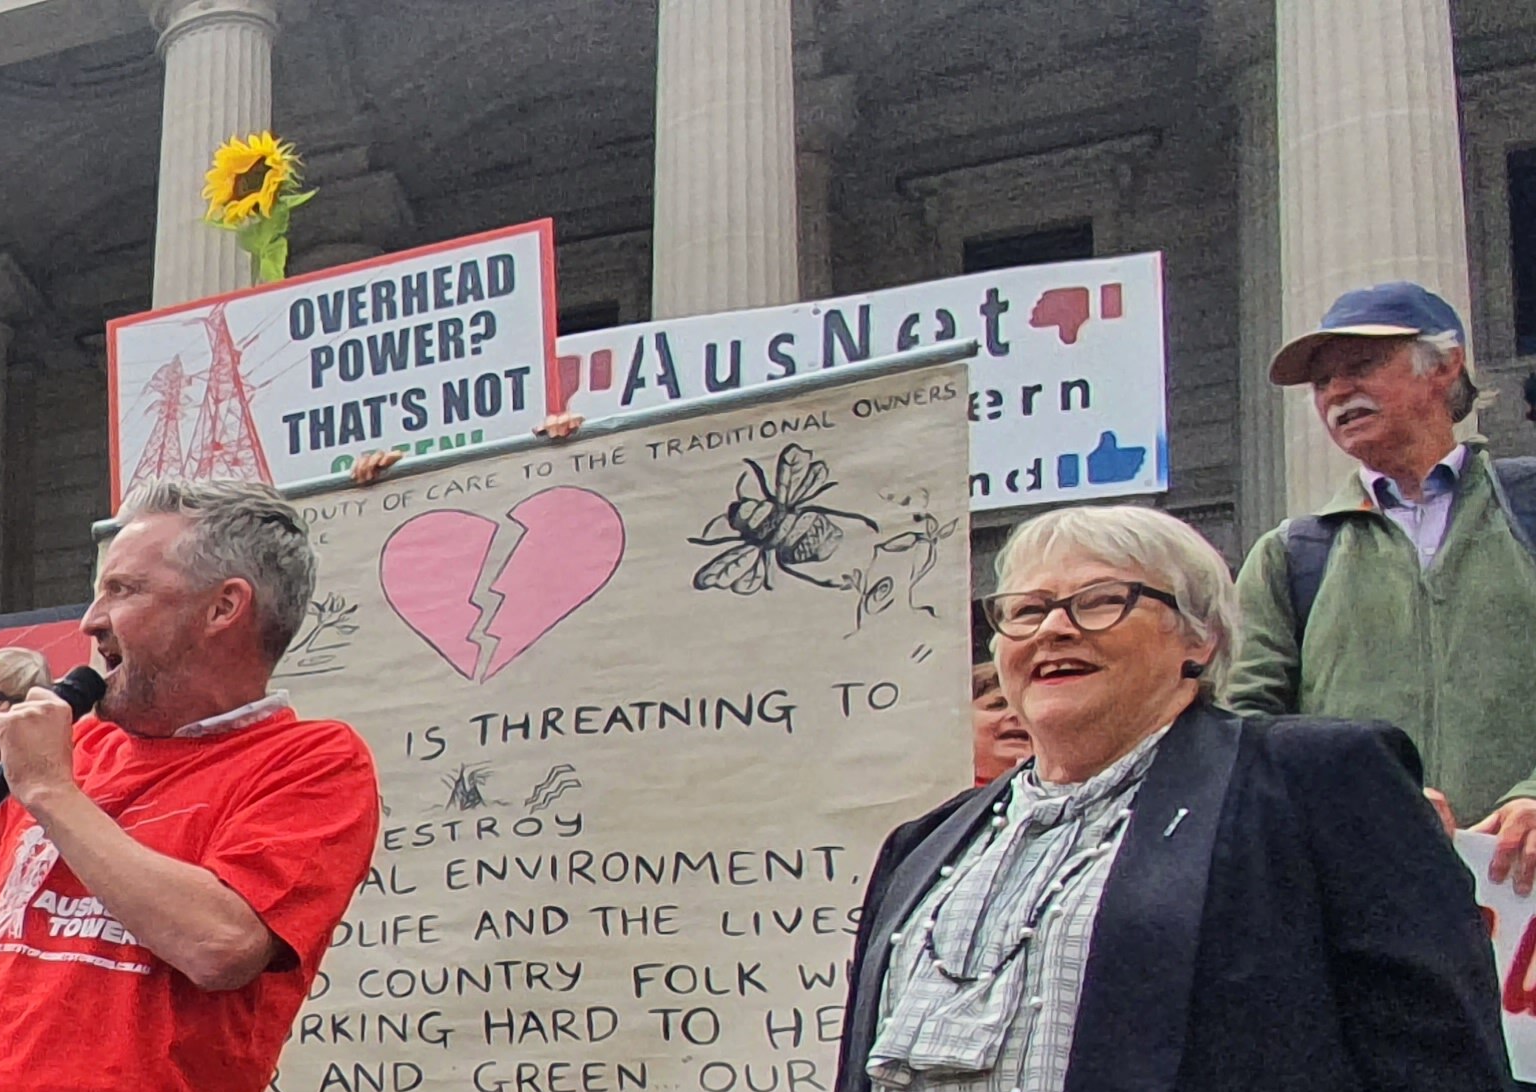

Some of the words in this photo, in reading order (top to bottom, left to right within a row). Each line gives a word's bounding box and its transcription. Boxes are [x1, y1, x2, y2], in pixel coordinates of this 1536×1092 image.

[289, 253, 515, 341] OVERHEAD
[310, 310, 496, 389] POWER?
[282, 387, 428, 455] THAT'S
[442, 366, 530, 426] NOT
[302, 499, 368, 525] DUTY
[383, 489, 414, 512] OF
[426, 471, 497, 501] CARE
[522, 461, 552, 480] TO
[570, 446, 627, 472] THE
[647, 410, 836, 461] TRADITIONAL
[852, 381, 957, 418] OWNERS
[406, 725, 448, 761] IS
[470, 689, 798, 749] THREATNING
[832, 681, 899, 714] TO
[474, 906, 570, 942] AND
[593, 905, 680, 936] THE
[720, 905, 864, 938] LIVES
[358, 960, 584, 998] COUNTRY
[633, 962, 768, 996] FOLK
[484, 1006, 619, 1046] HARD
[652, 1006, 722, 1046] TO
